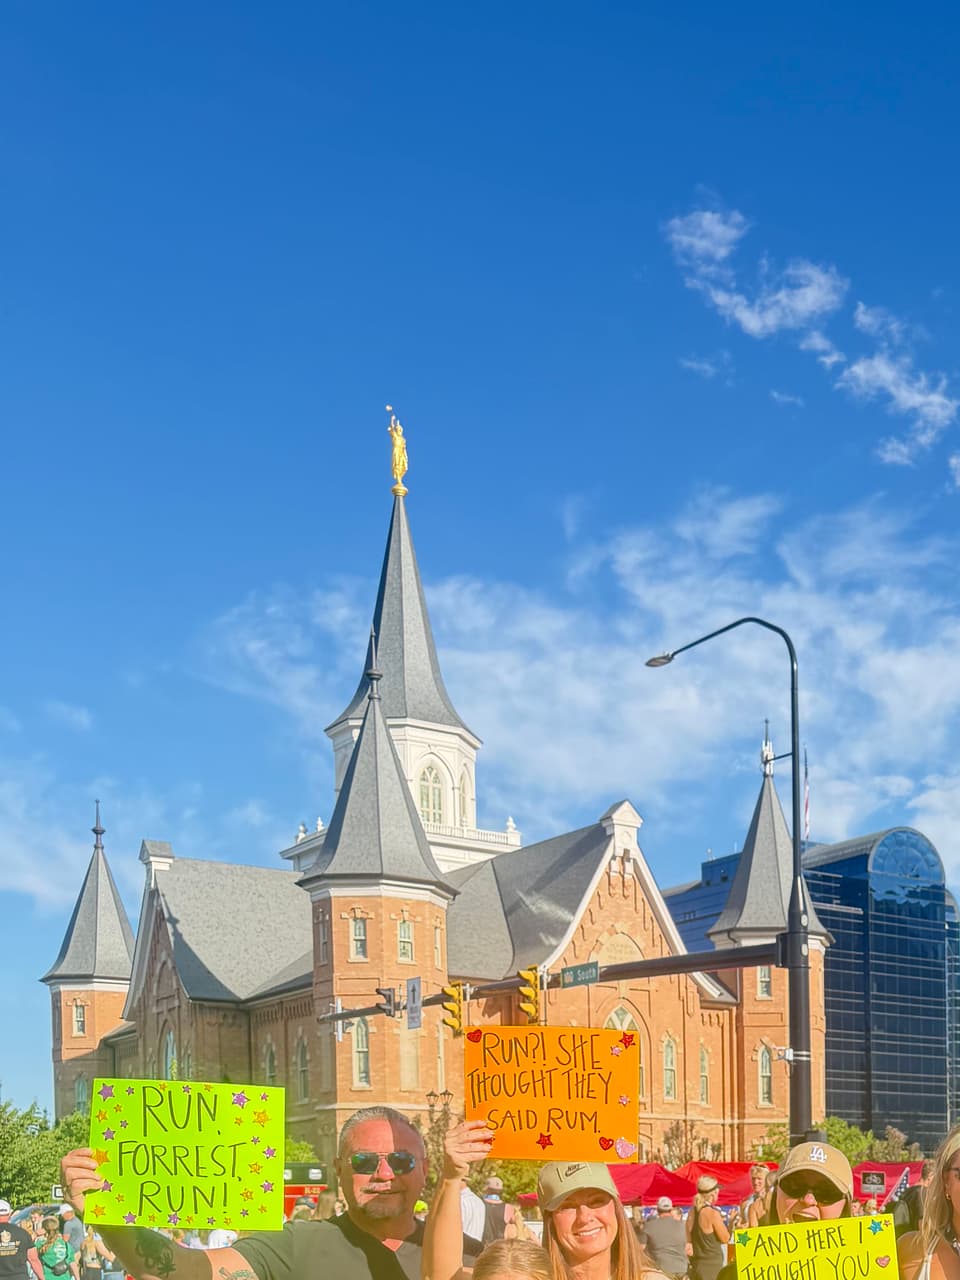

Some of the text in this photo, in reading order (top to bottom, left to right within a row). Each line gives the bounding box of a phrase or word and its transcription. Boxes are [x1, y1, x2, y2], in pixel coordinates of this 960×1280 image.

[483, 1032, 603, 1071] RUN?! SHE
[467, 1068, 612, 1108] THOUGHT THEY
[142, 1085, 221, 1137] RUN,
[487, 1108, 601, 1133] SAID RUM.
[118, 1140, 247, 1182] FORREST,
[809, 1145, 827, 1163] LA
[138, 1180, 228, 1217] RUN!
[753, 1221, 863, 1257] AND HERE I
